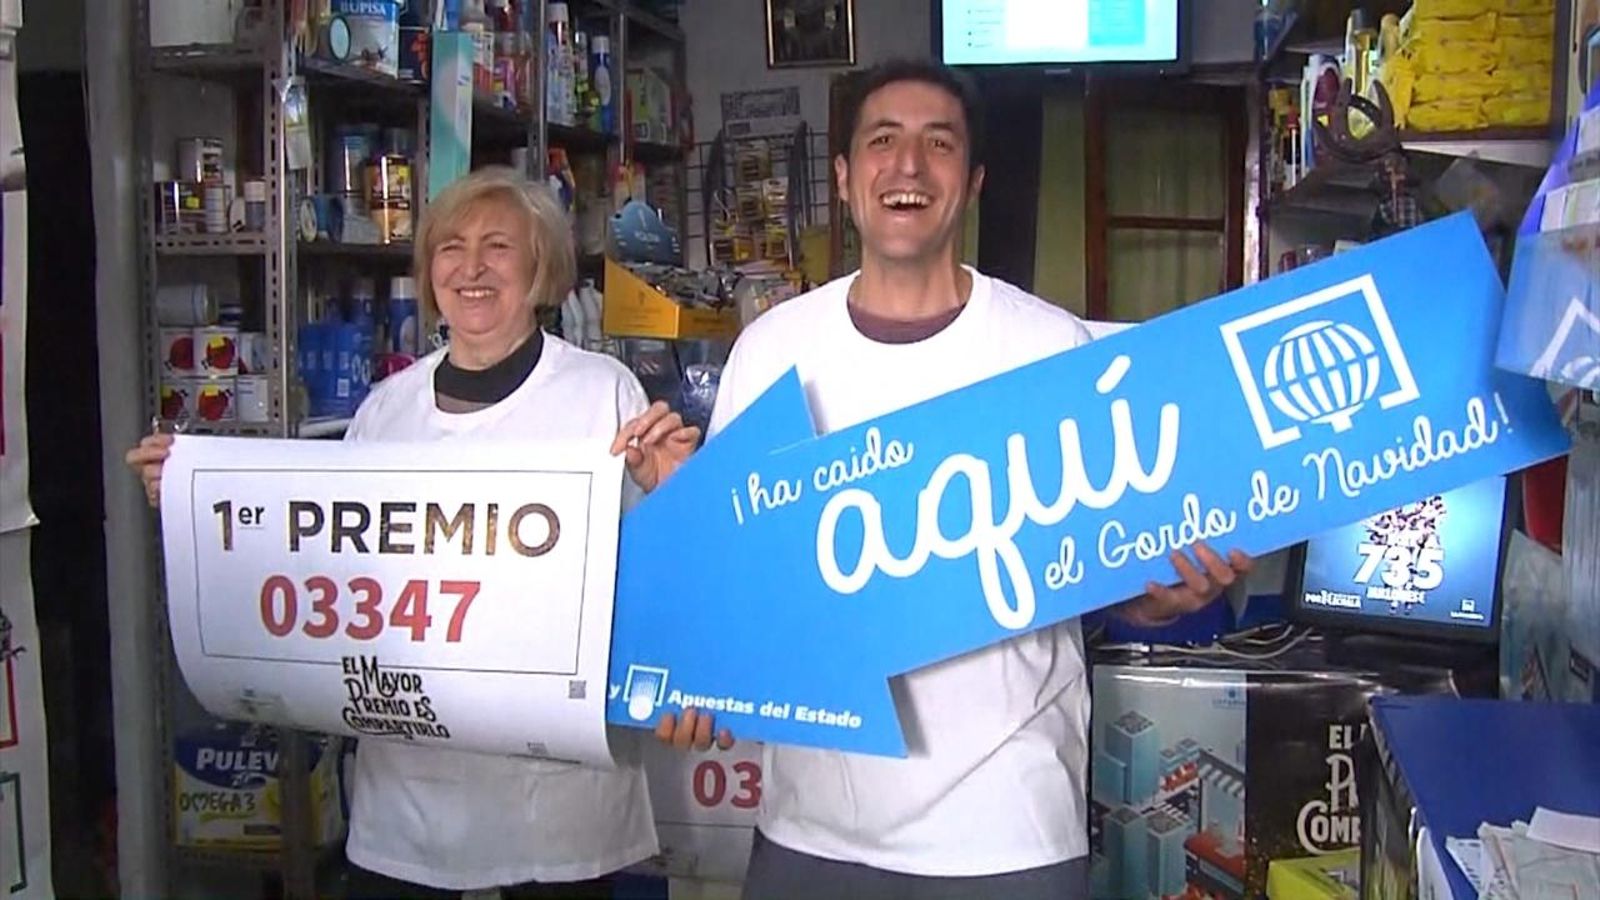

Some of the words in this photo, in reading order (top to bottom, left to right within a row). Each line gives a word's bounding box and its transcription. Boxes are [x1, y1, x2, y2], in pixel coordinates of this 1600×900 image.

[816, 354, 1180, 630] aquí
[213, 500, 265, 552] 1er
[288, 501, 561, 558] PREMIO
[1044, 535, 1084, 591] el
[1097, 493, 1236, 568] Gordo
[1247, 470, 1301, 522] de
[1354, 542, 1446, 591] 735
[260, 574, 481, 642] 03347
[342, 656, 359, 674] EL
[360, 655, 423, 698] MAYOR
[344, 678, 411, 717] PREMIO
[414, 696, 437, 722] ES
[342, 706, 451, 740] COMPARTIRLO
[608, 683, 622, 699] y
[667, 689, 754, 714] Apuestas
[759, 702, 790, 719] del
[794, 705, 863, 729] Estado
[196, 747, 279, 771] PULEV
[692, 759, 762, 809] 03
